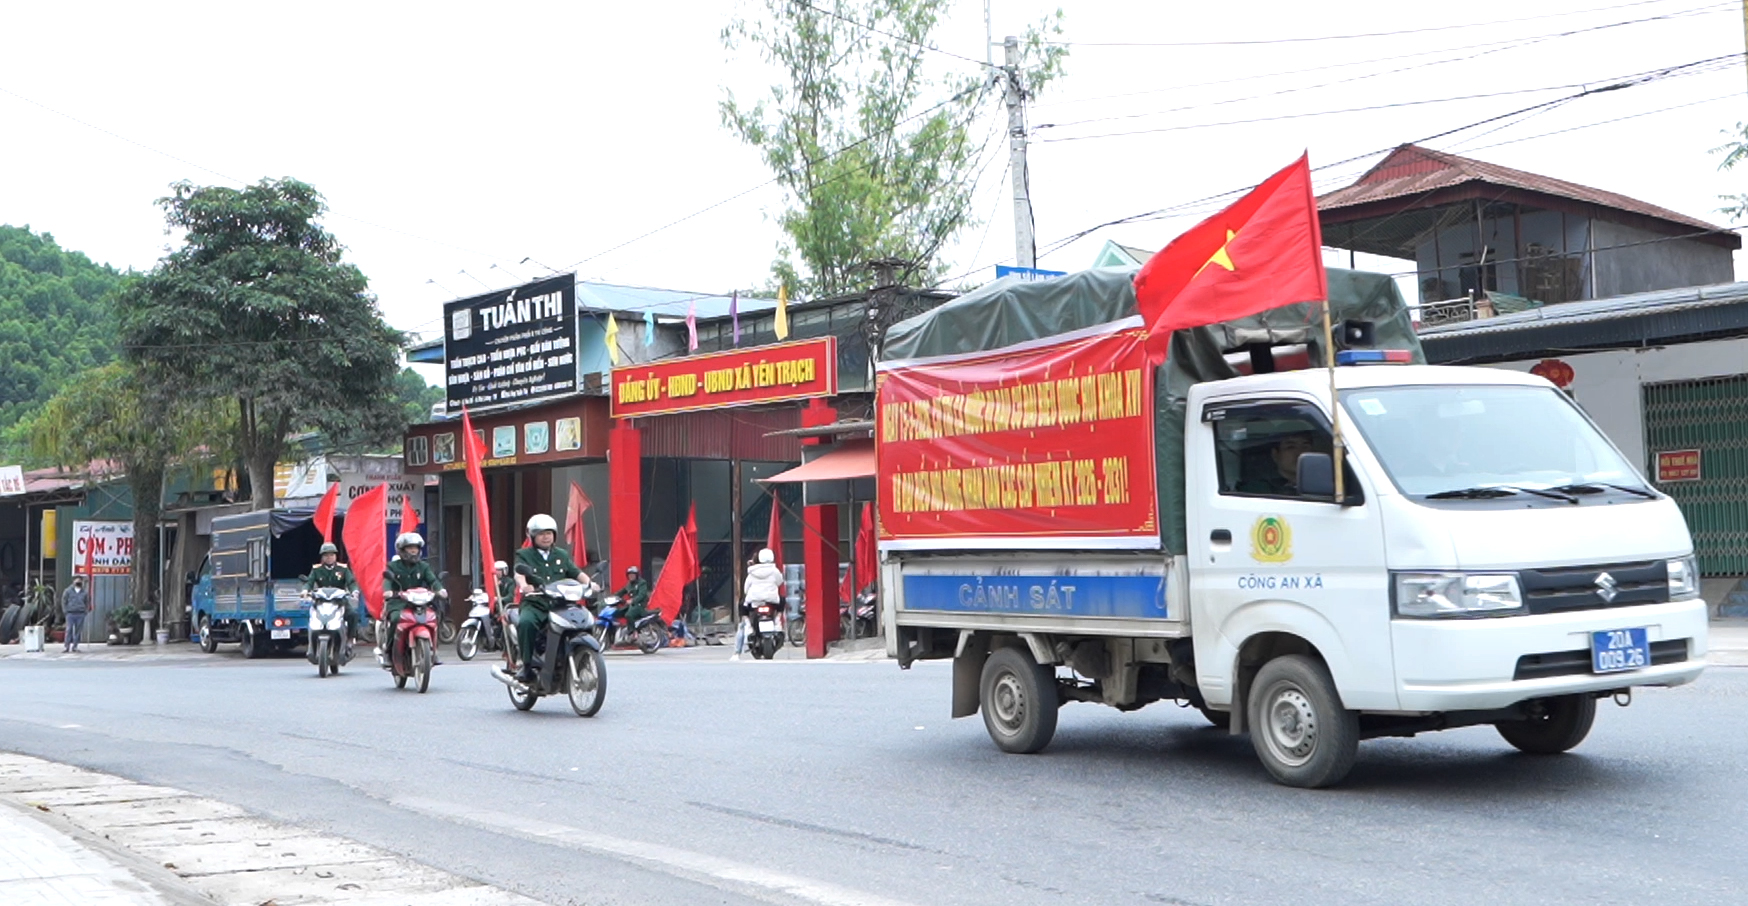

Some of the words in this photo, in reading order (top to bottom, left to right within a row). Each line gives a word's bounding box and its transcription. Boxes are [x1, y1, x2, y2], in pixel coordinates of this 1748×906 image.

[480, 289, 531, 331] TUẤN
[532, 291, 563, 322] THỊ
[619, 375, 646, 404] ĐẢNG
[668, 374, 698, 398] HĐND
[704, 369, 735, 393] UBND
[735, 362, 752, 390] XÃ
[752, 360, 777, 387] YÊN
[776, 358, 816, 387] TRẠCH
[116, 537, 134, 555] PH
[1238, 573, 1276, 589] CÔNG
[1280, 577, 1300, 589] AN
[1304, 572, 1324, 589] XÃ
[958, 576, 1019, 608] CẢNH
[1028, 578, 1076, 610] SÁT
[1606, 630, 1634, 649] 20A
[1599, 648, 1645, 669] 009.26
